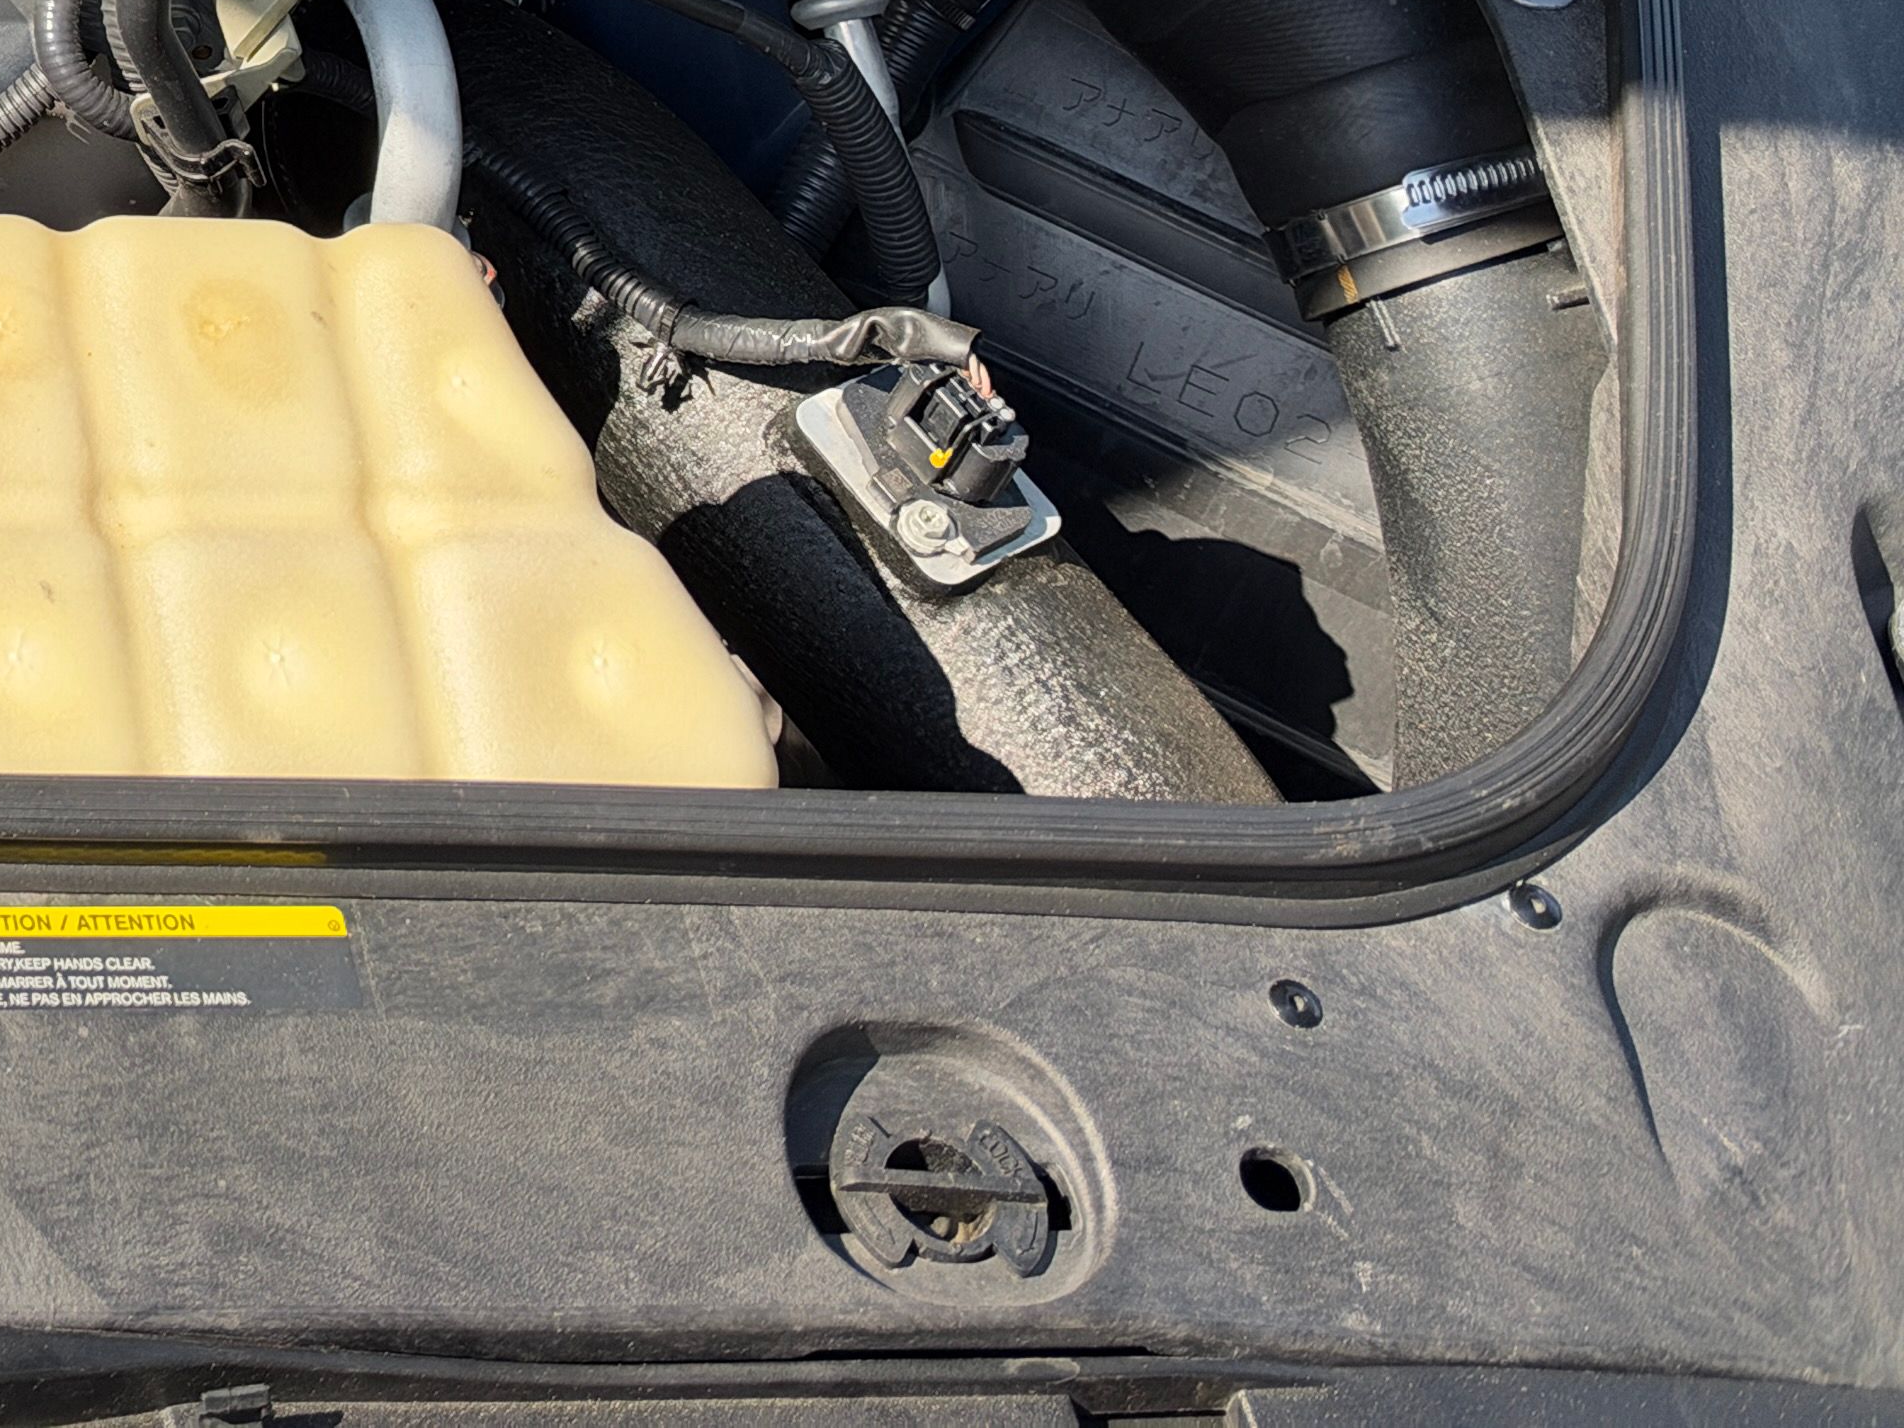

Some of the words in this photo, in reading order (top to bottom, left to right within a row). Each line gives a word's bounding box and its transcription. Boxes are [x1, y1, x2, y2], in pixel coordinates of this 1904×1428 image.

[60, 913, 69, 933] /
[76, 912, 196, 933] ATTENTION
[52, 957, 103, 971] HANDS
[105, 957, 155, 972] CLEAR.
[68, 975, 105, 990] TOUT
[106, 975, 172, 991] MOMENT.
[9, 992, 31, 1007] NE
[31, 992, 60, 1007] PAS
[61, 992, 83, 1007] EN
[84, 992, 172, 1007] APPROCHER
[174, 992, 200, 1007] LES
[200, 992, 251, 1007] MAINS.
